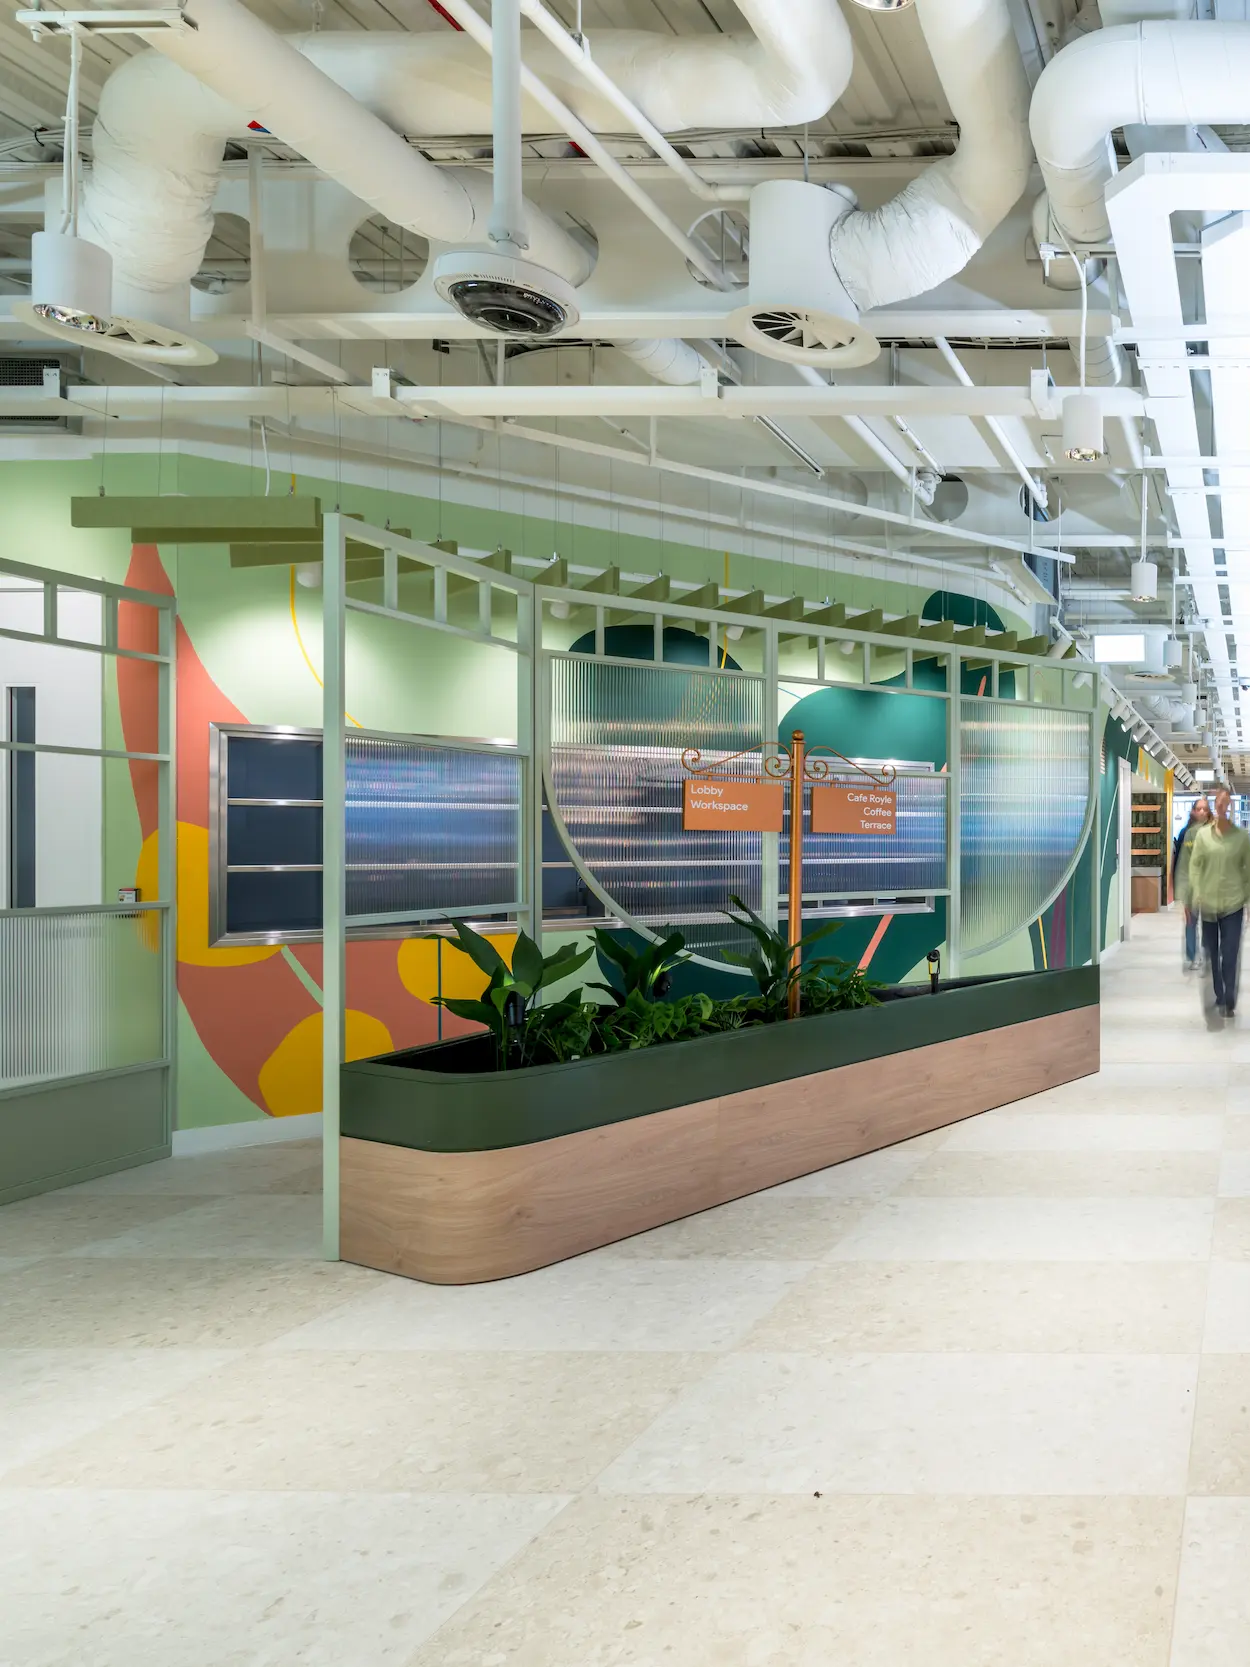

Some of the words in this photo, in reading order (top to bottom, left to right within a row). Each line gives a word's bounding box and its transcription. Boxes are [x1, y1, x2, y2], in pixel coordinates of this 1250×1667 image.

[690, 784, 723, 797] Lobby
[847, 792, 868, 802] Cafe
[869, 794, 892, 805] Royle
[690, 799, 749, 812] Workspace
[863, 807, 892, 817] Coffee
[860, 820, 892, 830] Terrace
